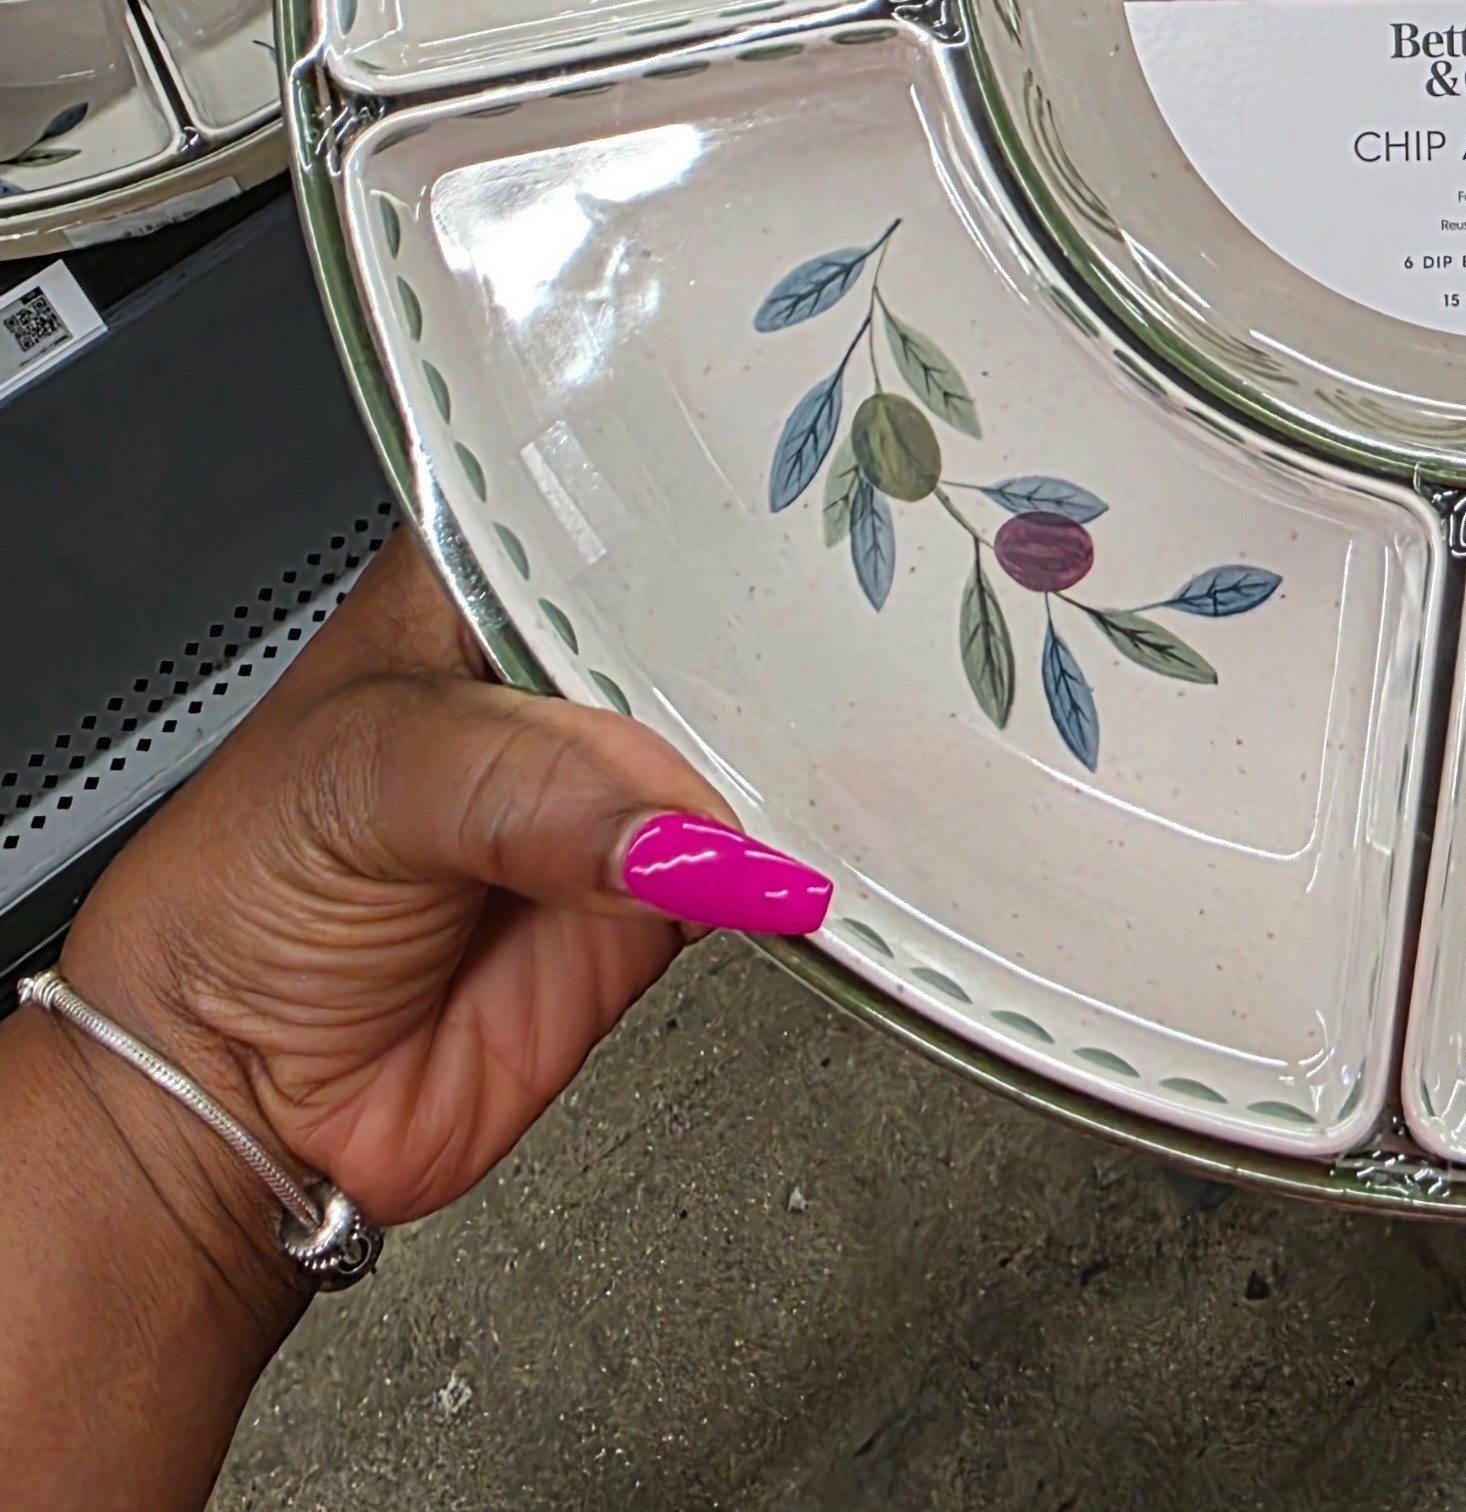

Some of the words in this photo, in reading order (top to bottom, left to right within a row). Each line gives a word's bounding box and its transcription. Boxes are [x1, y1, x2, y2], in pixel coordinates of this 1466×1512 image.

[1353, 130, 1446, 163] CHIP
[1404, 255, 1414, 269] 6
[1423, 255, 1453, 269] DIP
[1443, 293, 1460, 307] 15
